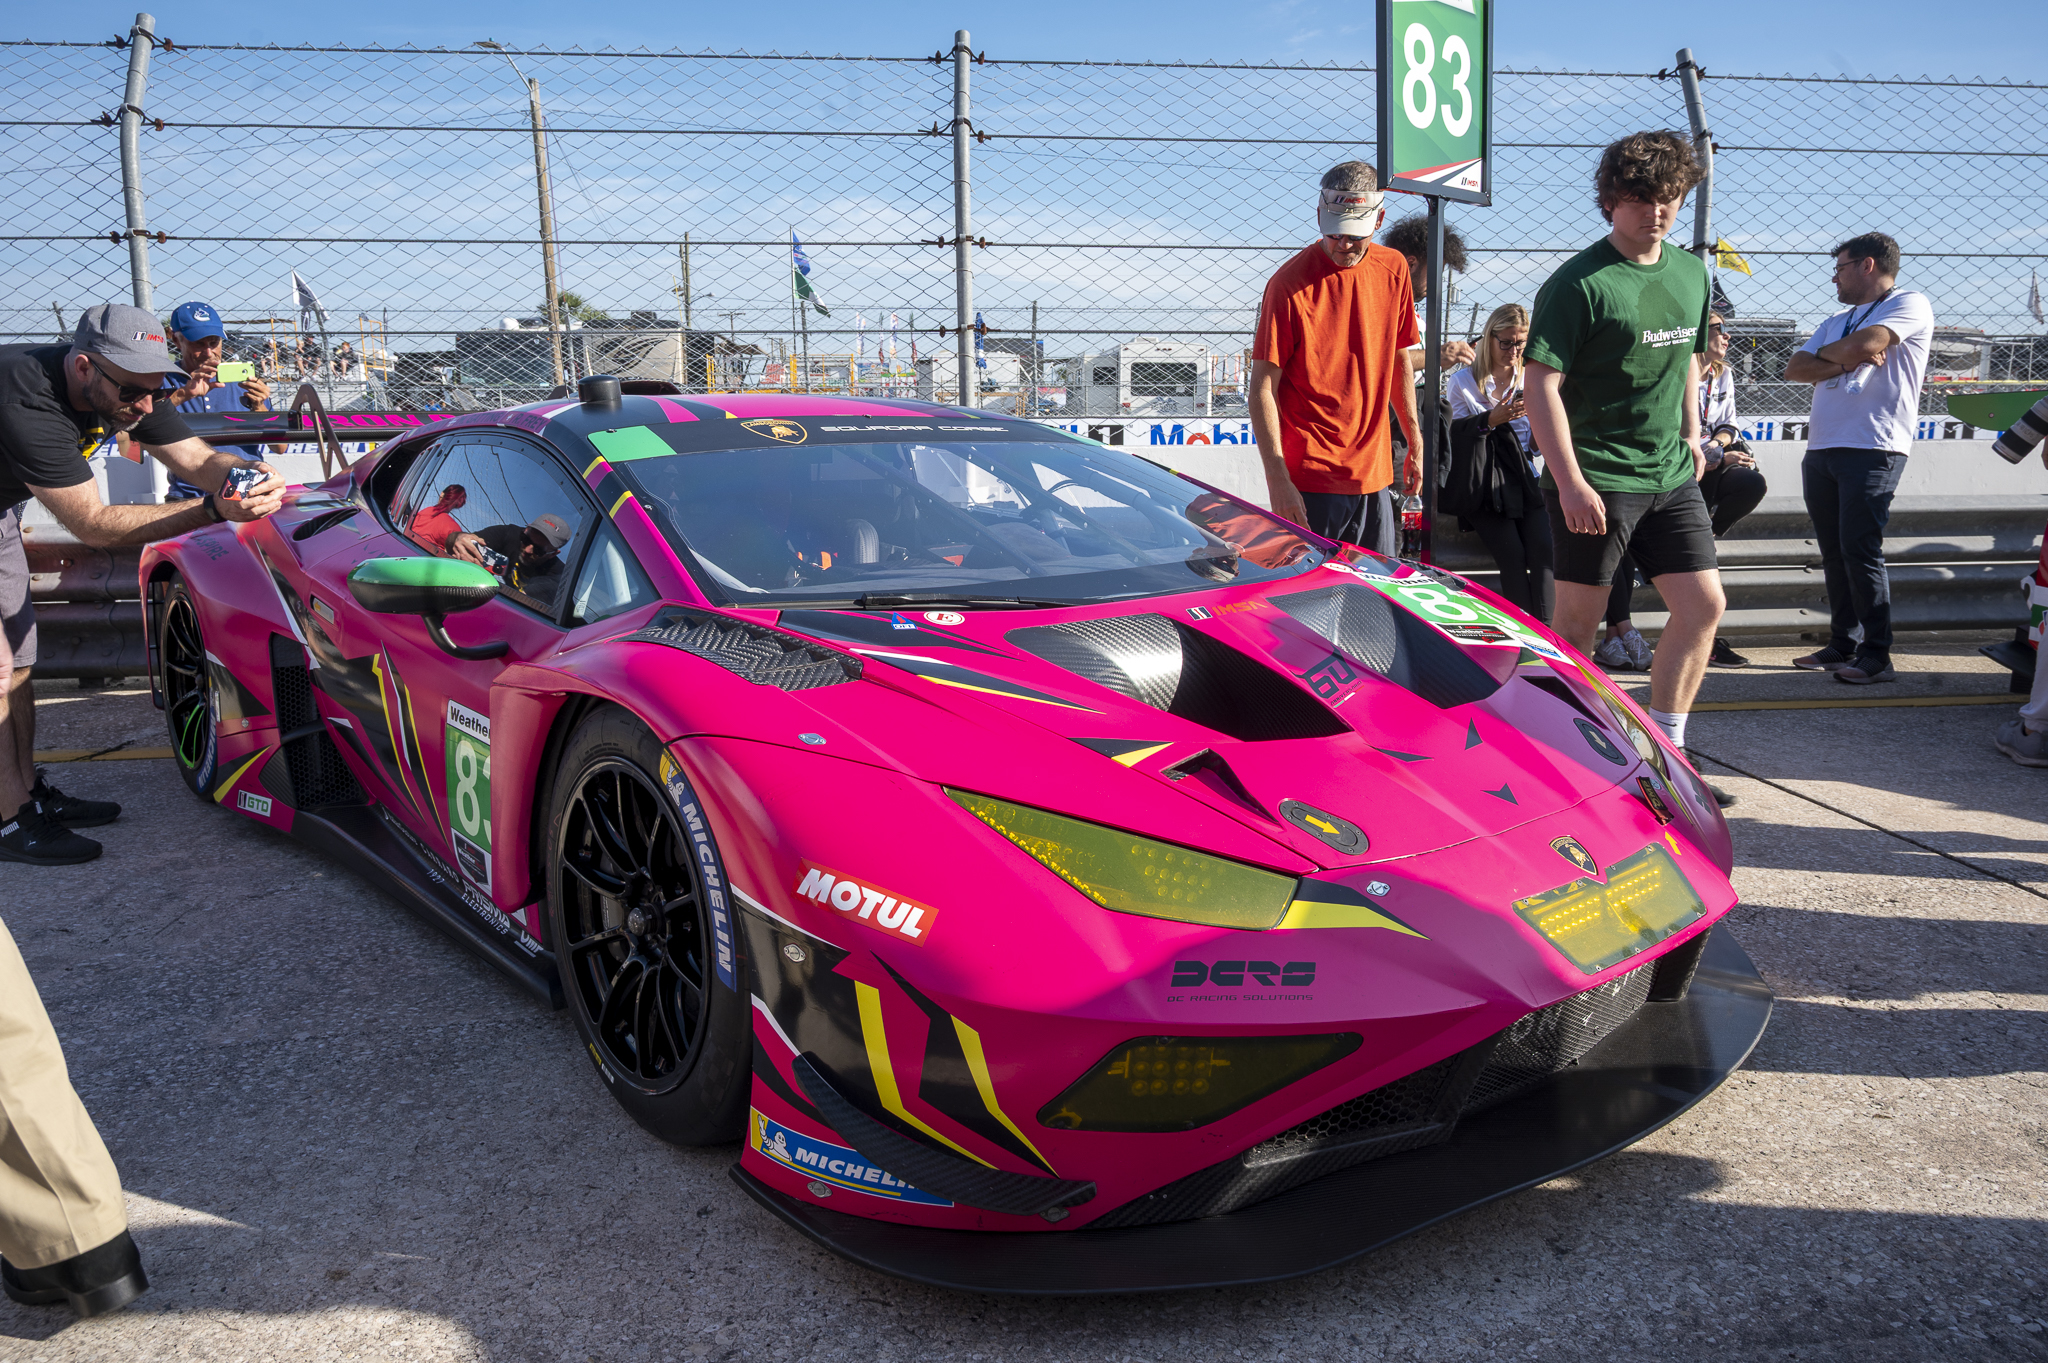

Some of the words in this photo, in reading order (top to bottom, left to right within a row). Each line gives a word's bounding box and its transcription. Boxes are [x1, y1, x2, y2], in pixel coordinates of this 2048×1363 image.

[1402, 22, 1473, 138] 83
[1642, 326, 1698, 344] Budweiser
[1212, 601, 1268, 616] IMSA
[247, 796, 269, 813] GTD
[455, 740, 491, 846] 8
[683, 802, 732, 973] MICHELIN
[797, 868, 925, 938] MOTUL
[461, 892, 509, 935] ELECTRONICS
[795, 1147, 919, 1189] MICHEL
